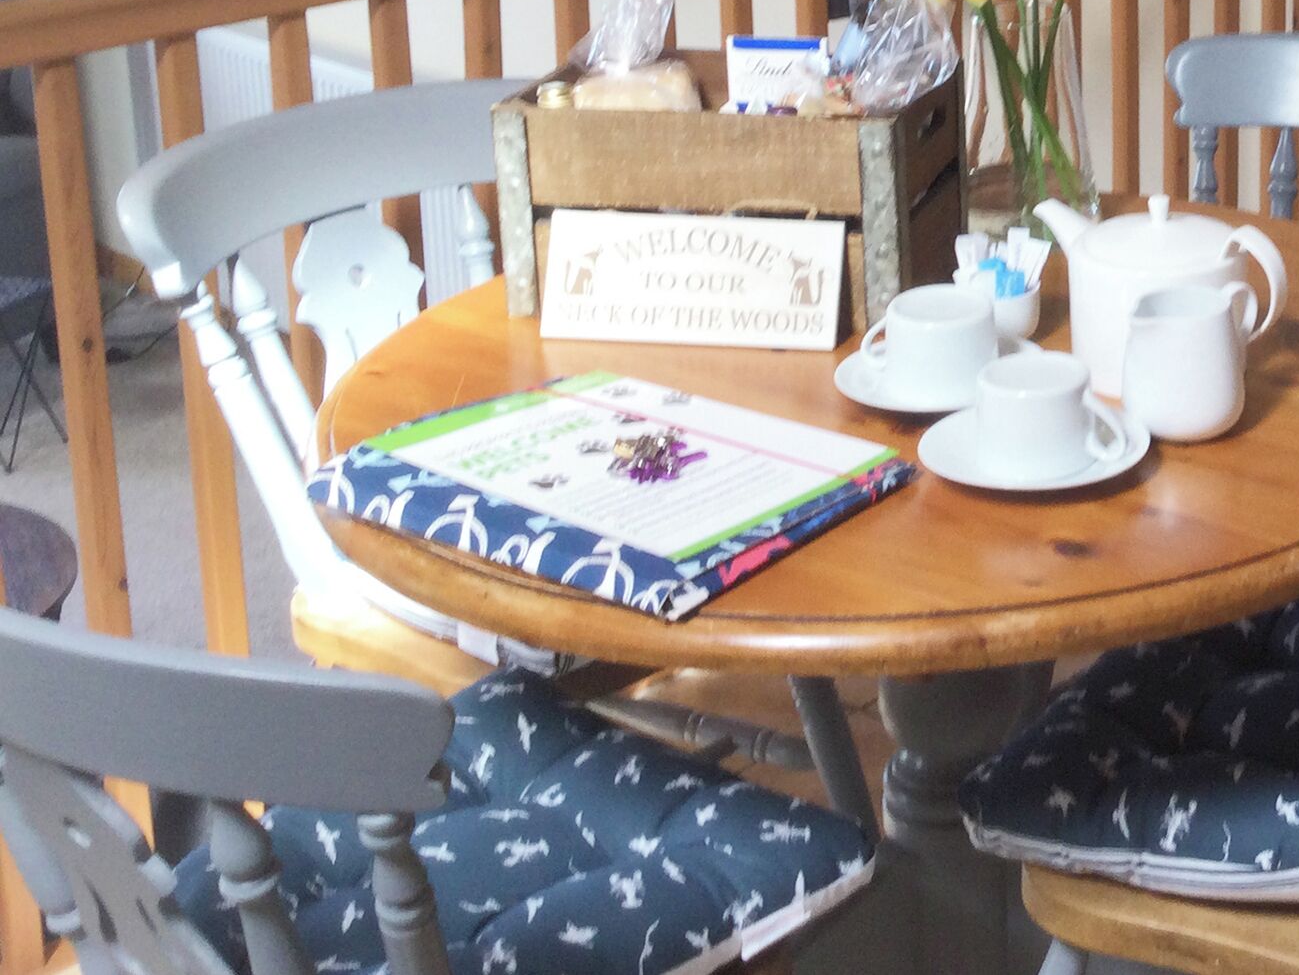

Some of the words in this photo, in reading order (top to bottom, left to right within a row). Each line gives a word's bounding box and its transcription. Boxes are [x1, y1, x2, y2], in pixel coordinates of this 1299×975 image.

[744, 55, 798, 76] Lind
[614, 226, 783, 274] WELCOME
[640, 271, 679, 290] TO
[684, 272, 746, 295] OUR
[630, 304, 665, 326] OF
[669, 306, 724, 330] THE
[730, 308, 825, 335] WOODS
